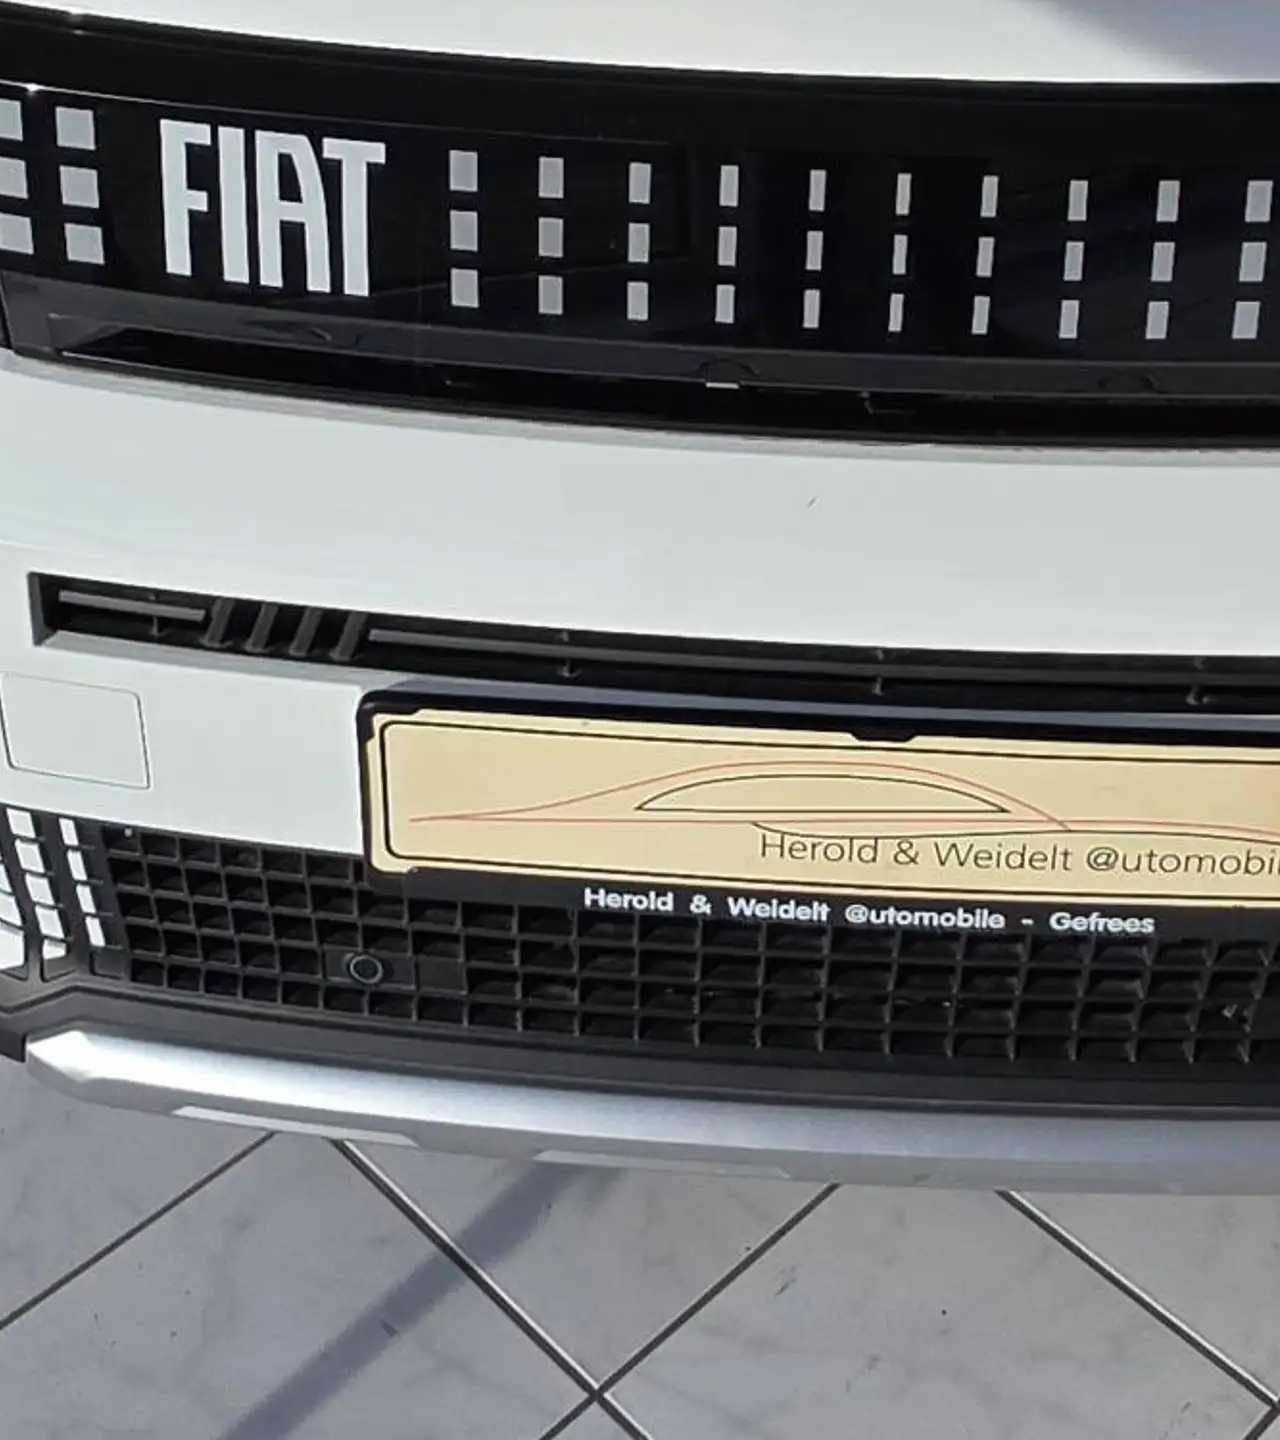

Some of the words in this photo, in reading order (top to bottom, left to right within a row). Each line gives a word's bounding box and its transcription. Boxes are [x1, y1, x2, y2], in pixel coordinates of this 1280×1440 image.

[160, 118, 386, 298] FIAT
[761, 833, 878, 864] Herold
[894, 839, 920, 865] &
[934, 841, 1072, 872] Weidelt
[584, 887, 674, 912] Herold
[689, 894, 712, 916] &
[727, 896, 831, 922] Weidelt
[845, 903, 1006, 929] @utomobile
[1049, 911, 1156, 934] Gefrees
